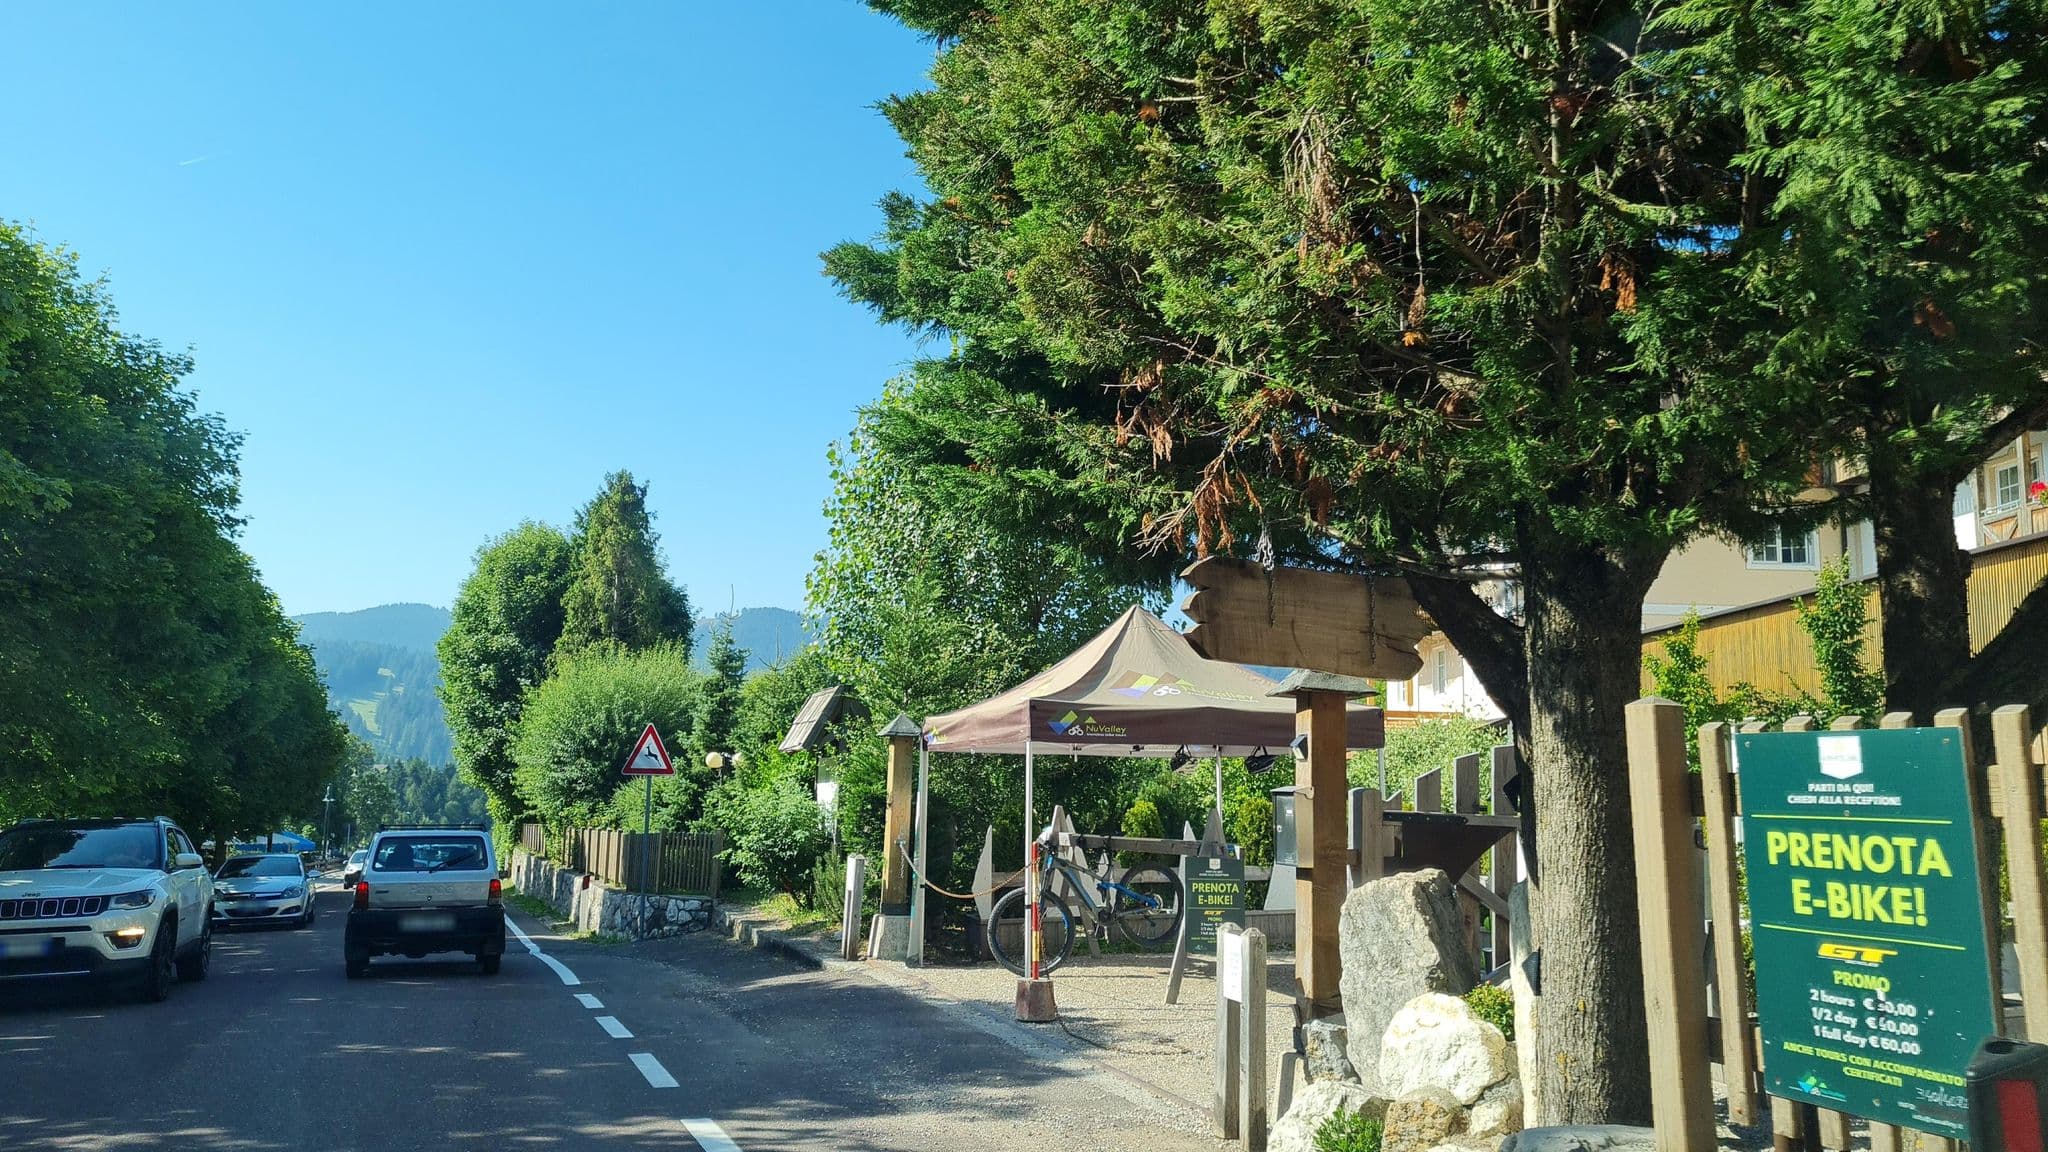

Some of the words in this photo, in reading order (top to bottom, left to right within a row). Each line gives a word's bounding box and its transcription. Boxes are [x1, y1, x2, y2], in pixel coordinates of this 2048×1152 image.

[1086, 724, 1127, 734] NuValley
[1807, 783, 1835, 792] PARTI
[1836, 783, 1852, 792] DA
[1787, 794, 1817, 804] CHIEDI
[1818, 795, 1843, 805] ALLA
[1766, 831, 1953, 877] PRENOTA
[1192, 883, 1239, 893] PRENOTA
[1198, 895, 1233, 905] E-BIKE!
[1791, 878, 1928, 927] E-BIKE!
[1818, 943, 1898, 963] GT
[1832, 970, 1891, 993] PROMO
[1809, 988, 1819, 1001] 2
[1820, 989, 1856, 1007] hours
[1862, 997, 1876, 1011] €
[1811, 1006, 1833, 1021] 1/2
[1834, 1010, 1858, 1028] day
[1865, 1016, 1878, 1030] €
[1813, 1025, 1821, 1037] 1
[1821, 1025, 1842, 1041] full
[1842, 1030, 1867, 1048] day
[1868, 1035, 1880, 1048] €
[1783, 1041, 1815, 1057] ANCHE
[1815, 1047, 1848, 1063] TOURS
[1848, 1054, 1872, 1067] CON
[1842, 1066, 1903, 1088] CERTIFICATI
